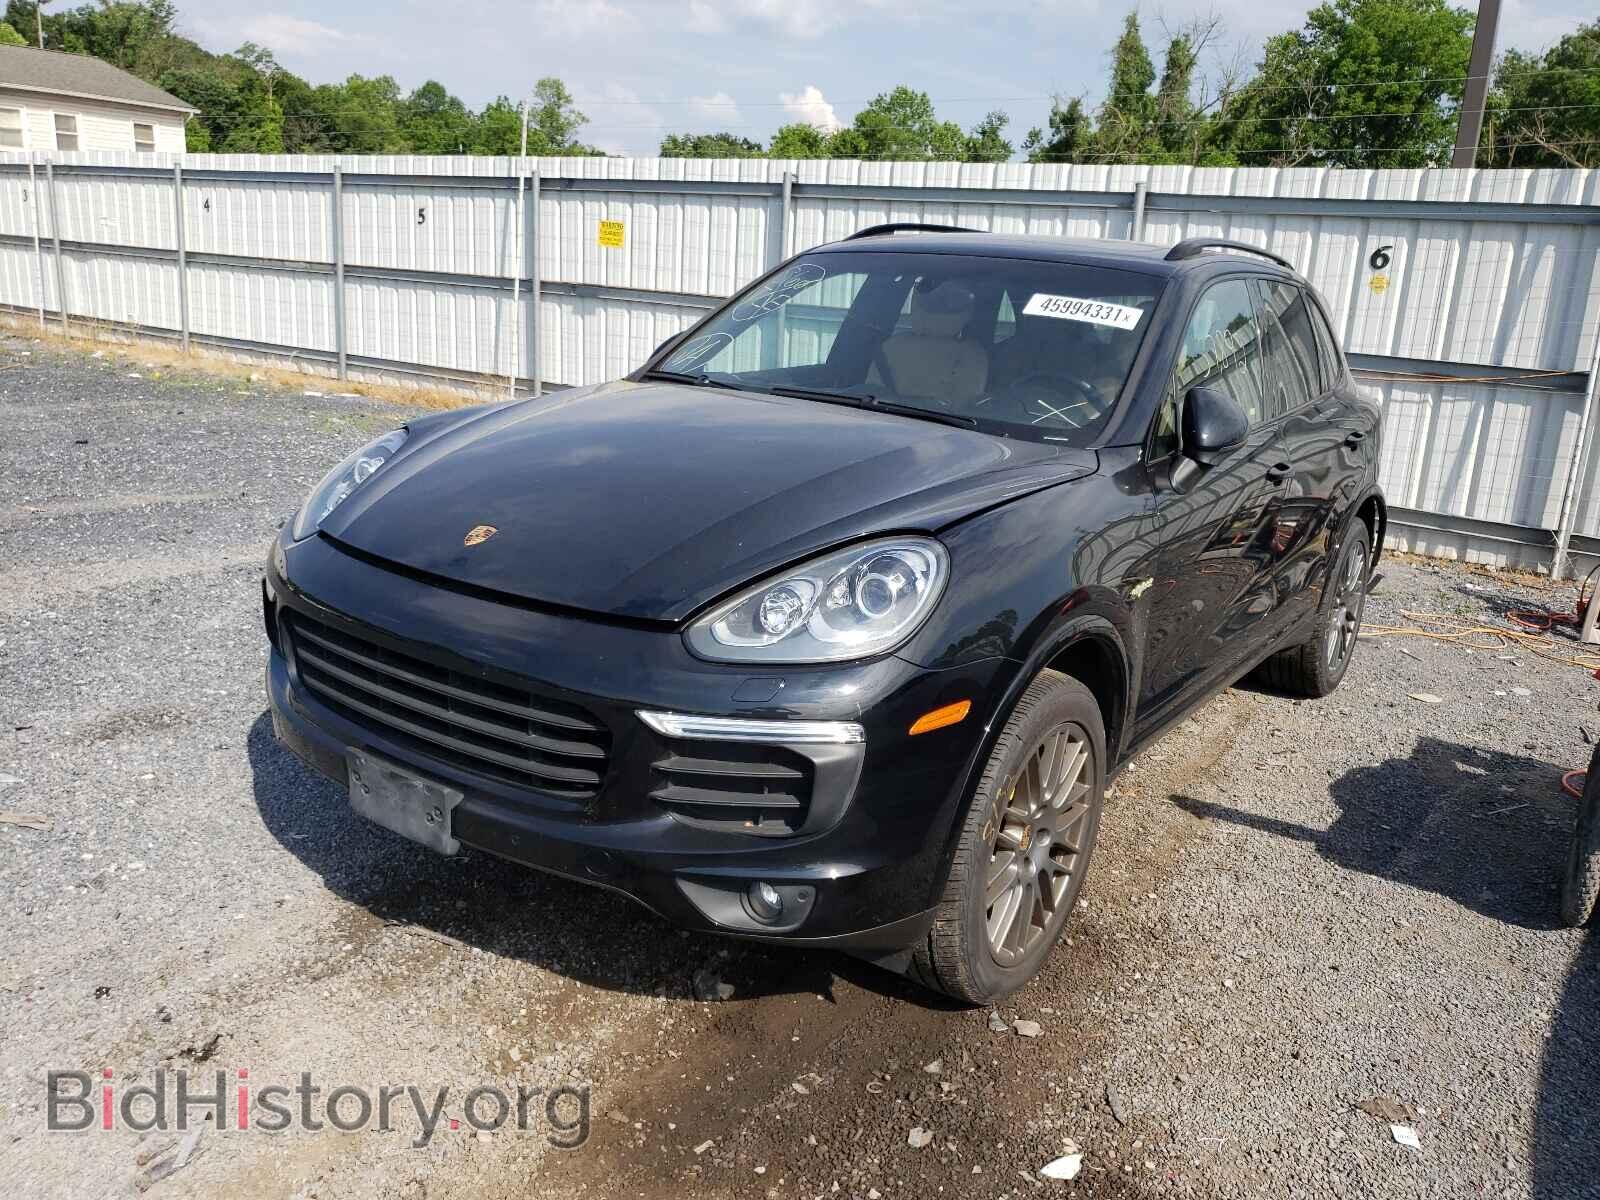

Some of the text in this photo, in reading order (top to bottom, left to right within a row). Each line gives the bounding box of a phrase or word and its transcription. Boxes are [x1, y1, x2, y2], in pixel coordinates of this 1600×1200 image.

[204, 198, 210, 213] 4
[417, 208, 425, 224] 5
[1370, 246, 1393, 270] 6
[1040, 298, 1122, 322] 45994331
